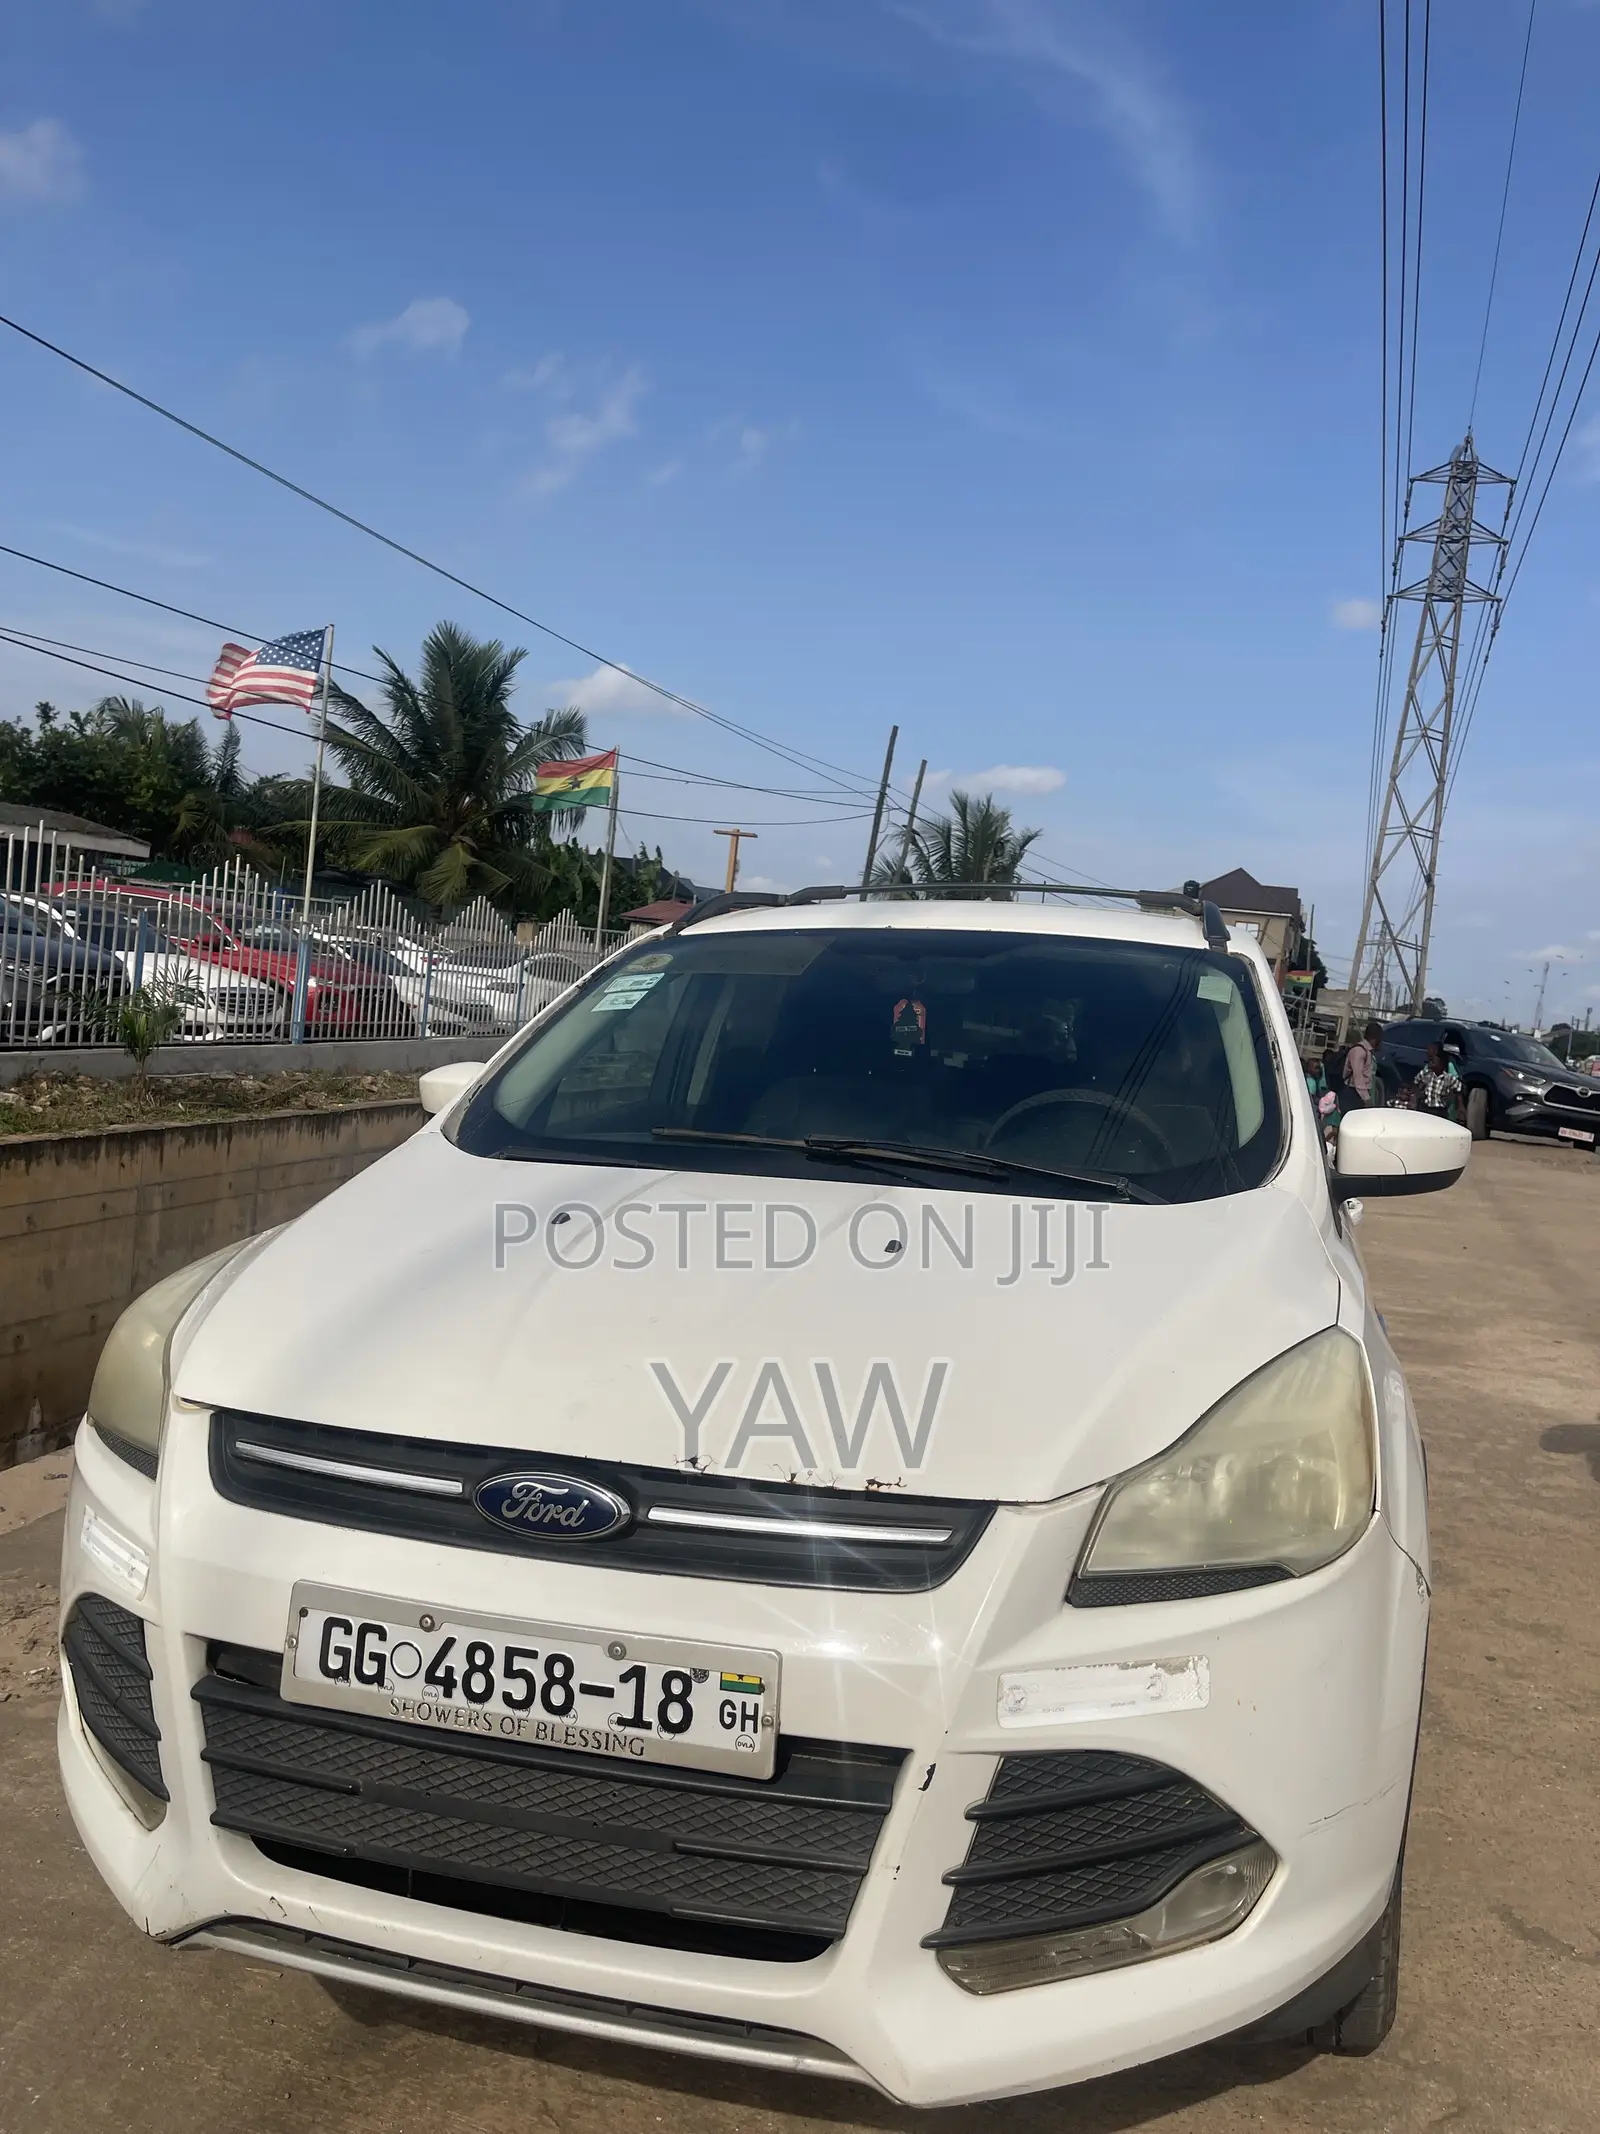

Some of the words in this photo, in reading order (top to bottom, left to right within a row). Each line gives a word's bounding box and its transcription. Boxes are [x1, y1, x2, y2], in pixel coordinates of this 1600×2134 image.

[501, 1481, 590, 1528] Ford
[318, 1616, 389, 1687] GG
[424, 1636, 694, 1734] 4858-18
[389, 1698, 493, 1732] SHOWERS
[500, 1716, 529, 1737] OF
[535, 1722, 645, 1757] BLESSING
[719, 1698, 760, 1734] GH
